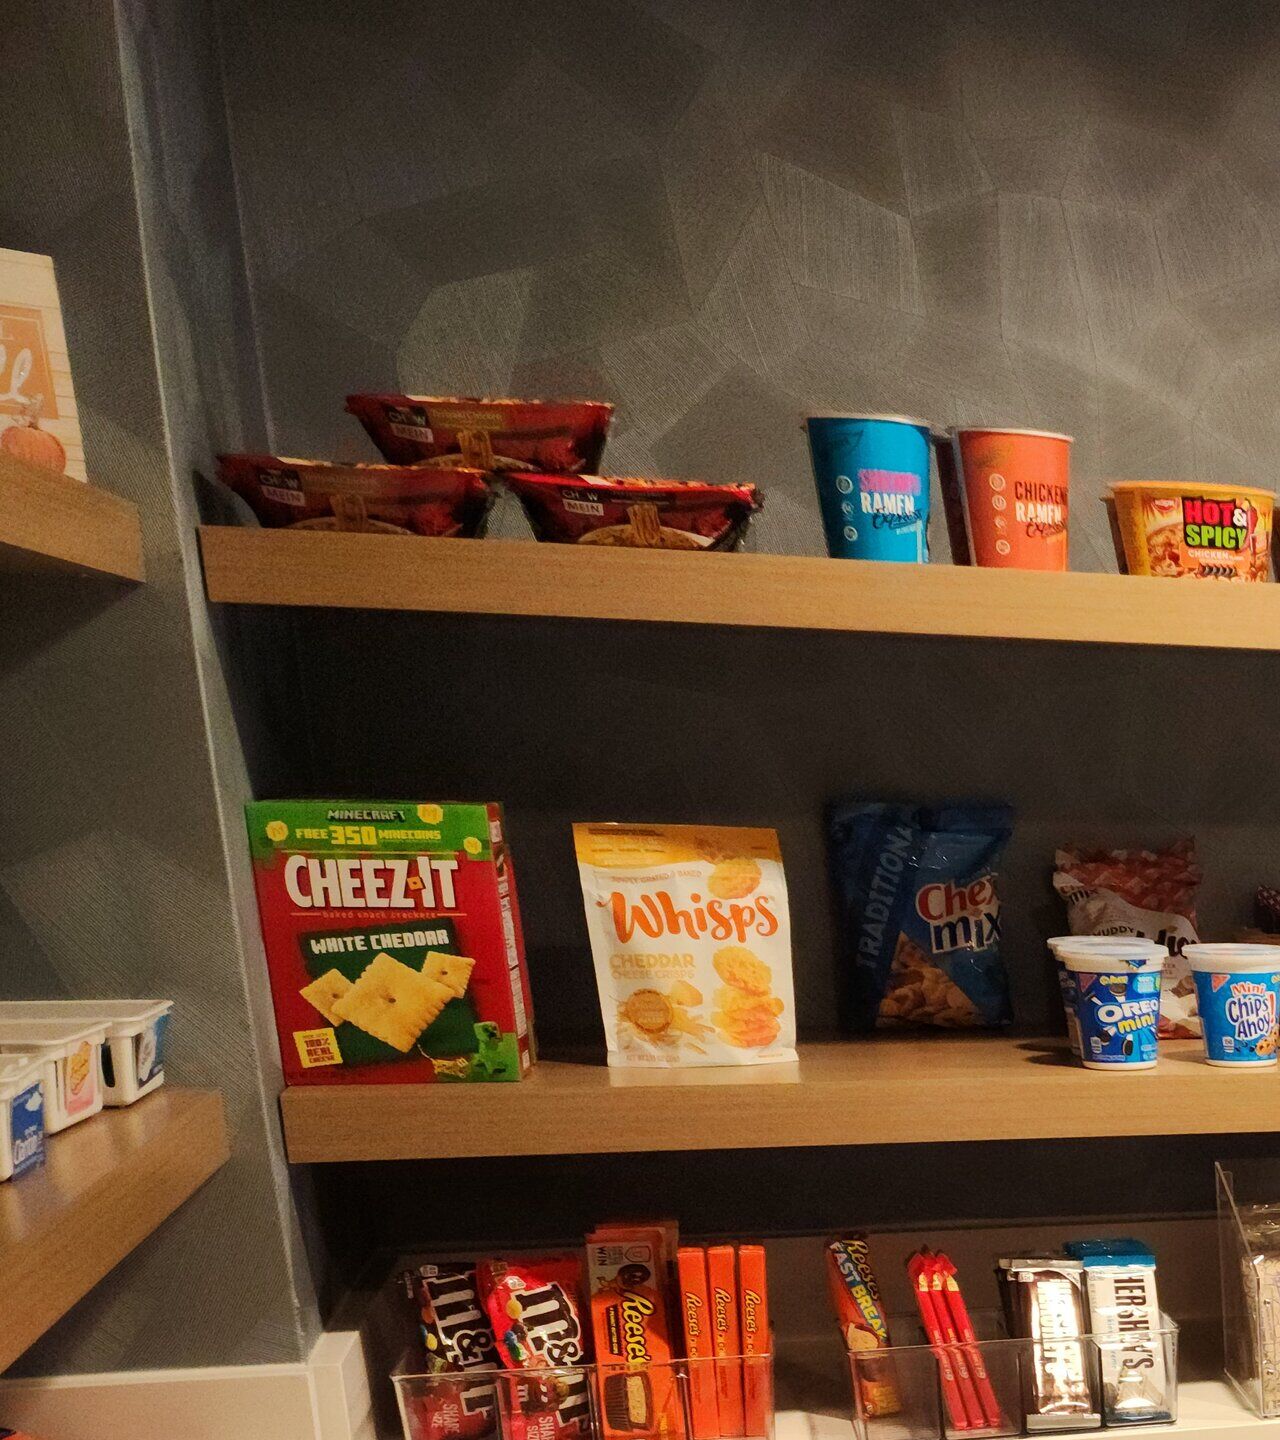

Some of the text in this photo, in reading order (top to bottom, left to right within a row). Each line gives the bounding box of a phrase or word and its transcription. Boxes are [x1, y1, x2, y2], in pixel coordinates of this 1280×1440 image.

[860, 491, 915, 515] RAMEN
[1014, 481, 1068, 502] CHICKEN
[1015, 501, 1062, 524] RAMEN
[1184, 499, 1237, 526] HOT
[1232, 508, 1248, 527] &
[1186, 524, 1247, 550] SPICY
[1187, 549, 1230, 561] CHICKEN
[326, 808, 406, 821] MINECRAFT
[295, 825, 442, 845] FREE 350 MINECOINS
[595, 890, 779, 944] Whisps
[310, 929, 450, 955] WHITE CHEDDAR
[933, 911, 1001, 952] mix
[609, 953, 696, 969] CHEDDAR
[1232, 983, 1267, 997] Mini
[1097, 999, 1160, 1024] OREO
[1228, 996, 1269, 1024] Chips
[597, 1246, 607, 1266] WIN
[685, 1291, 702, 1337] Reese's
[714, 1287, 731, 1333] Reese's
[744, 1289, 761, 1334] Reese's
[619, 1290, 655, 1363] Reese's
